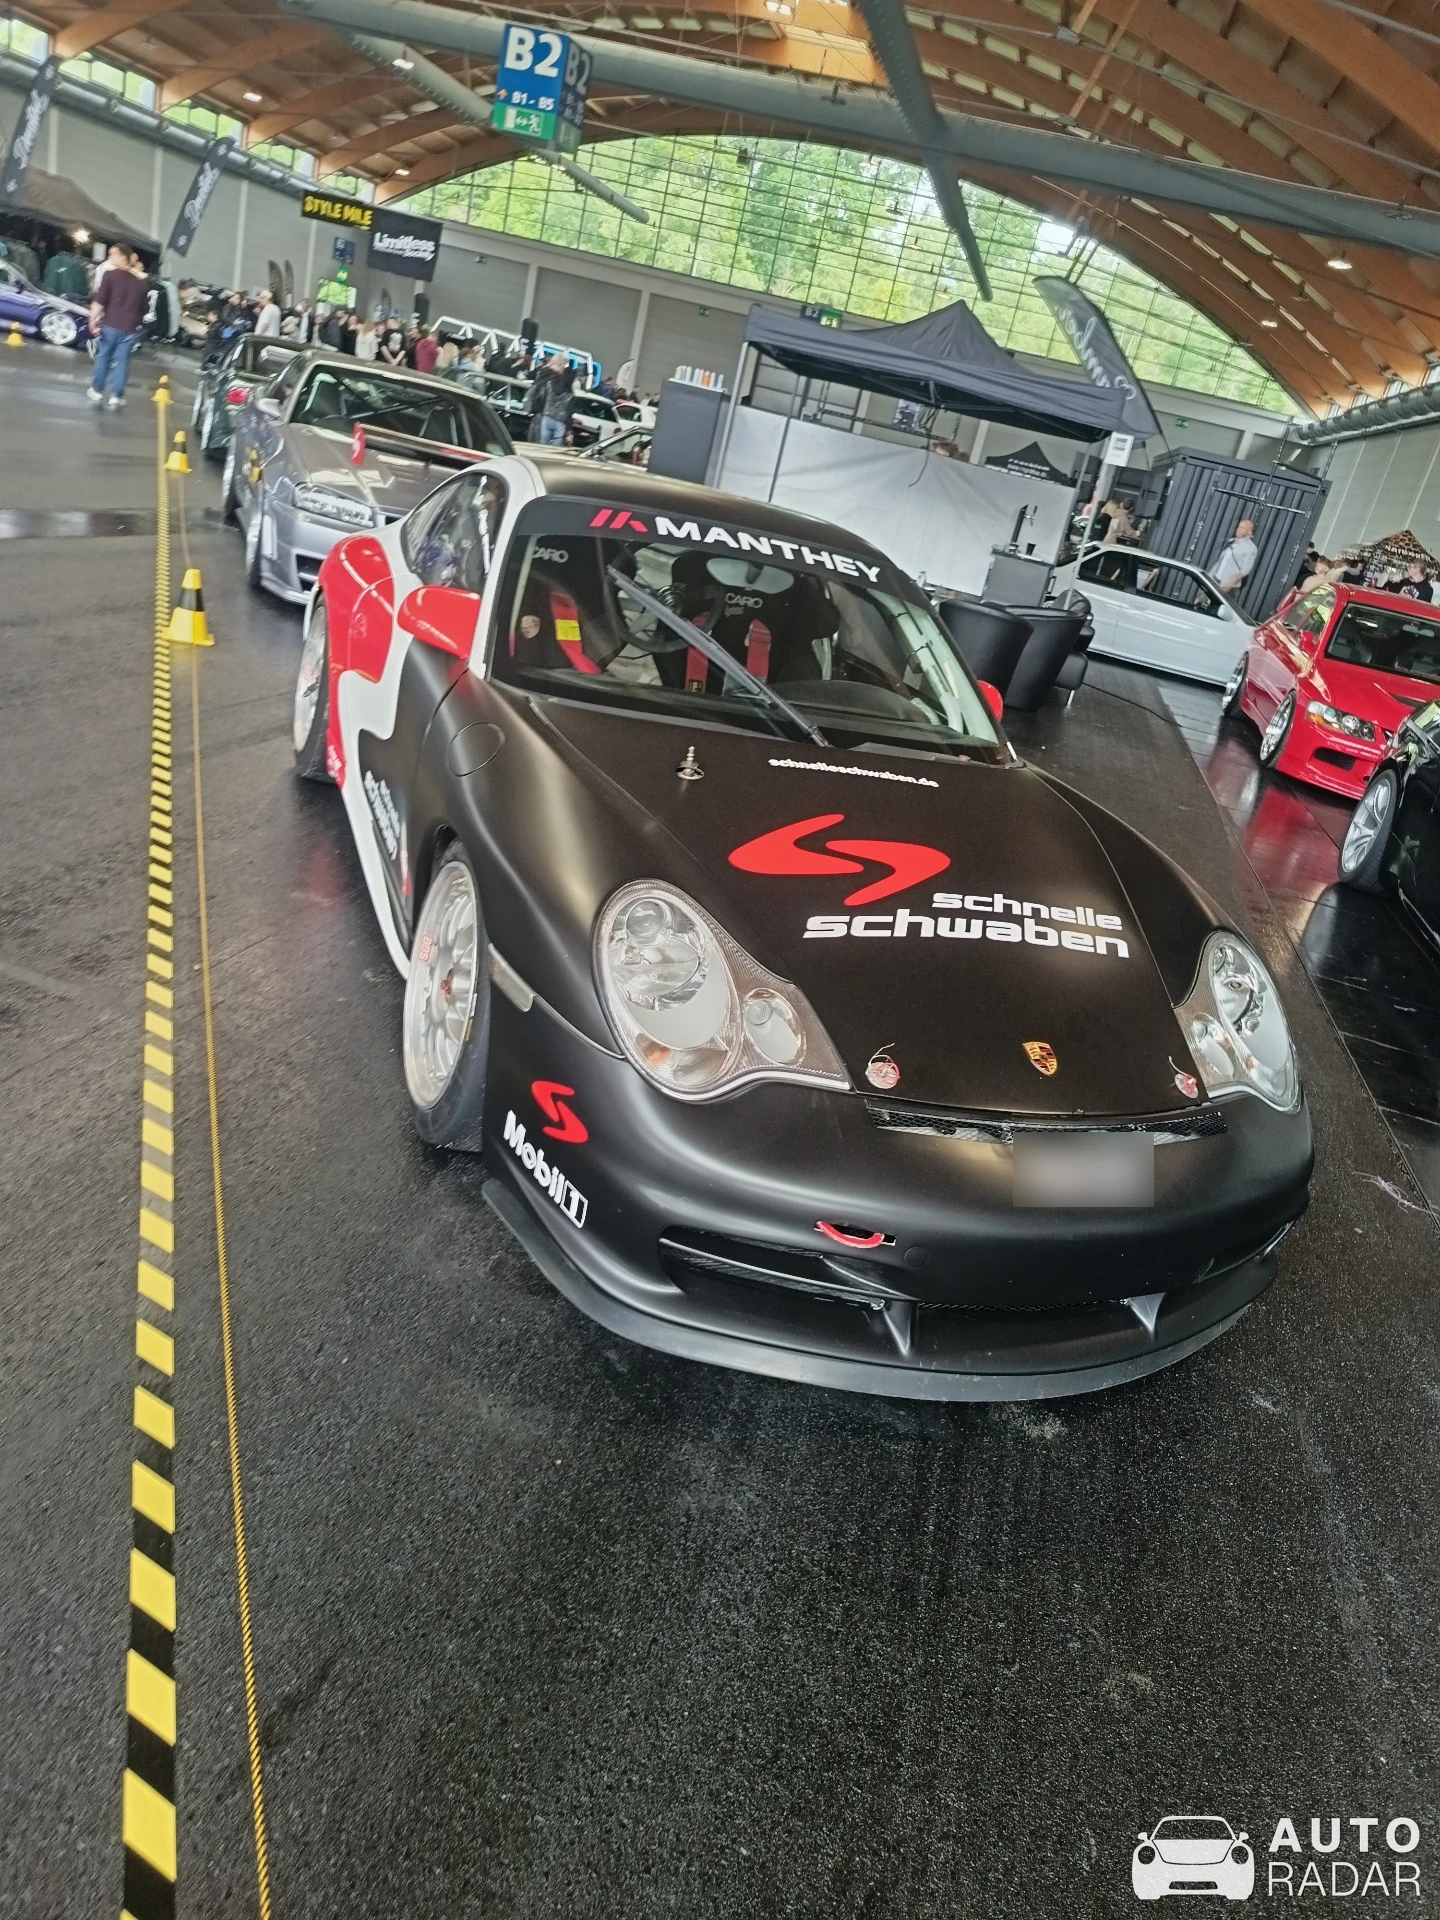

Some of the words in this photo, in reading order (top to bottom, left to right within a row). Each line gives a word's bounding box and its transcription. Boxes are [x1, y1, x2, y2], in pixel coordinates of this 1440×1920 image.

[504, 26, 563, 78] B2
[564, 42, 590, 96] B2
[304, 195, 342, 219] STYLE
[373, 231, 436, 252] Limitless
[805, 307, 819, 318] B2
[654, 515, 881, 583] MANTHEY
[768, 758, 939, 788] schnelleschwaben.de
[931, 892, 1123, 930] schnelle
[420, 934, 433, 962] BBS
[802, 908, 1130, 958] schwaben
[503, 1109, 565, 1205] Mobil
